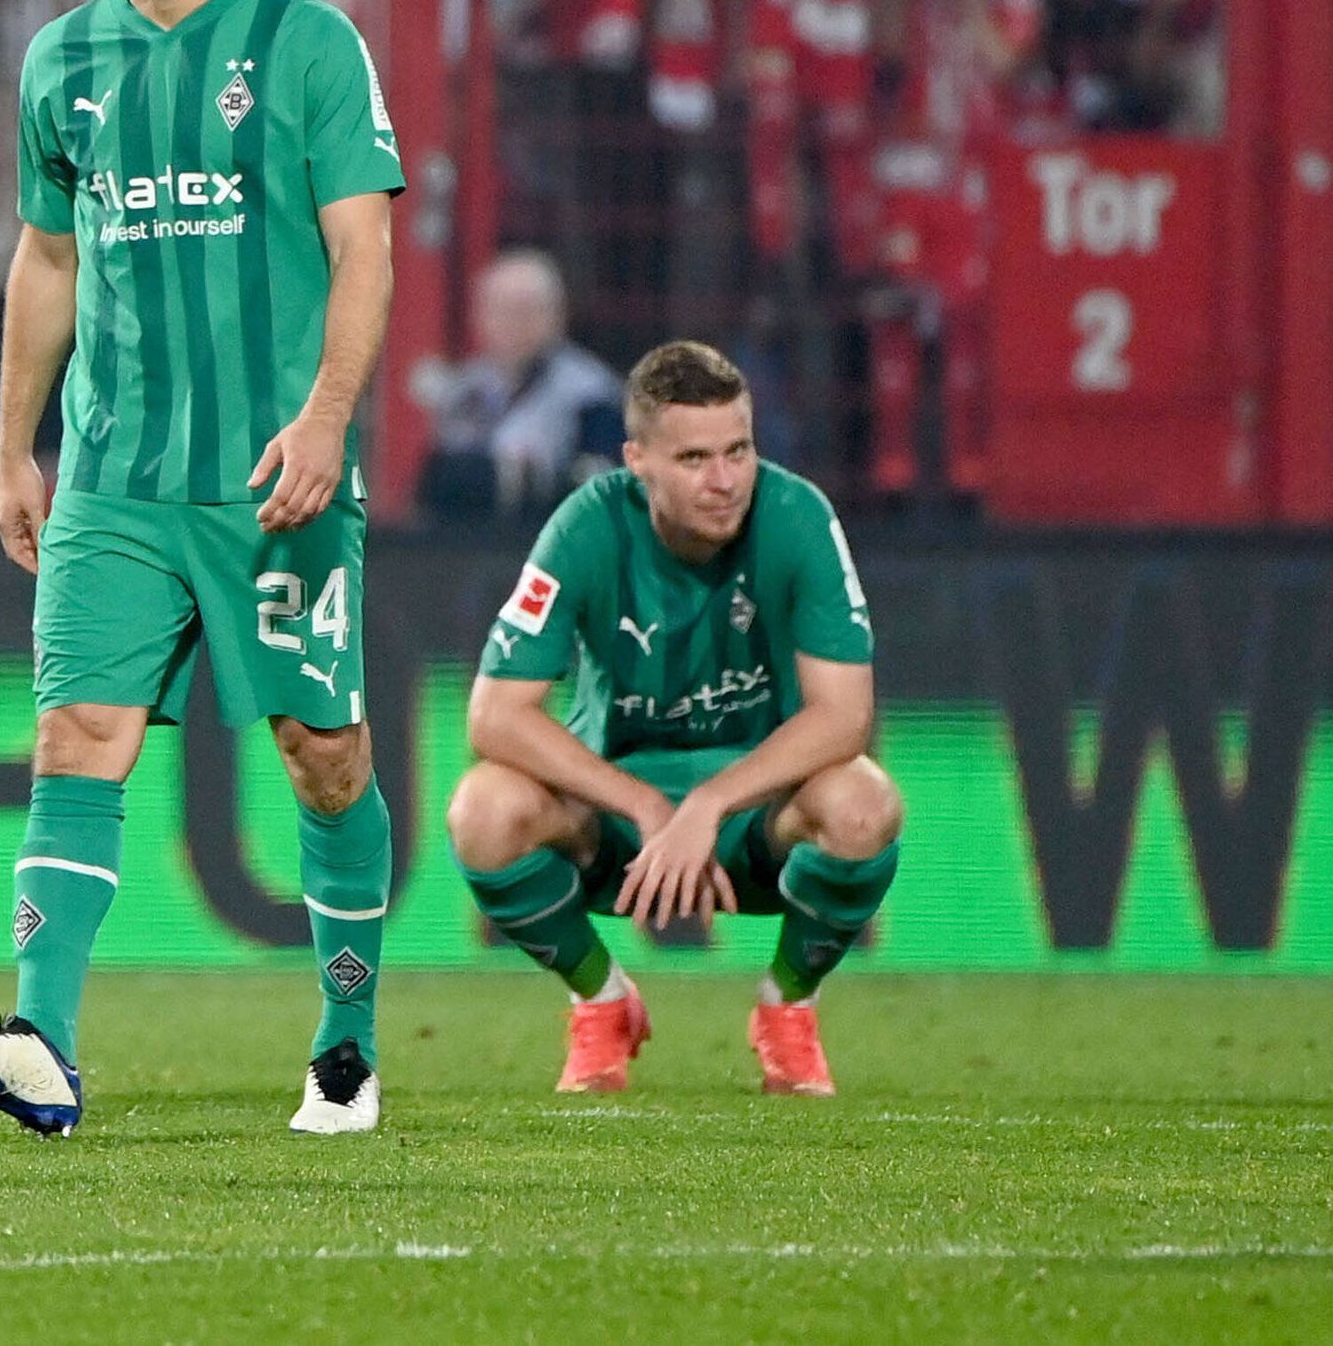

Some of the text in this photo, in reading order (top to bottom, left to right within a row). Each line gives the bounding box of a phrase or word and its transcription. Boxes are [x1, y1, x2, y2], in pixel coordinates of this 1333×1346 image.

[1031, 154, 1175, 256] Tor
[1071, 287, 1133, 391] 2
[256, 566, 350, 655] 24
